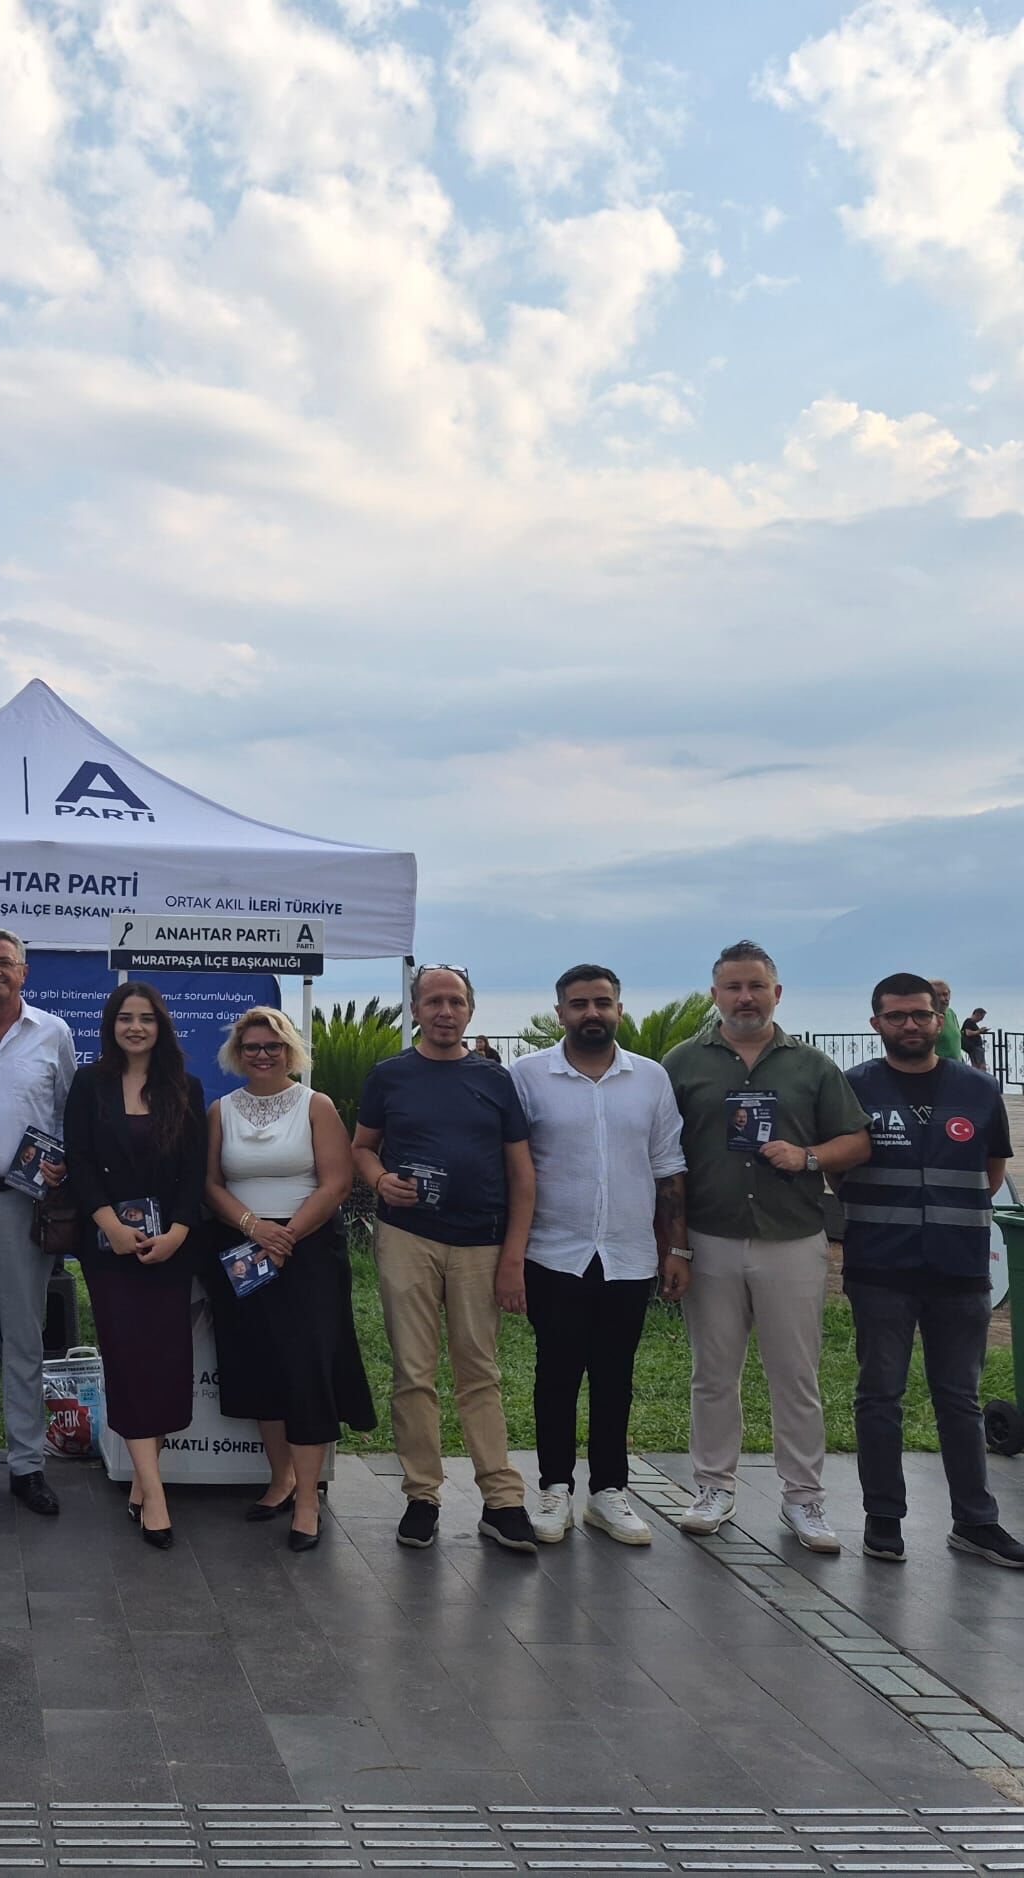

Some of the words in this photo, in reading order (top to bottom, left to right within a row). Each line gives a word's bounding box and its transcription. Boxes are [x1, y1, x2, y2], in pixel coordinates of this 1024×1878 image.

[55, 760, 151, 810] A
[68, 871, 139, 897] PARTİ
[21, 901, 51, 918] İLÇE
[165, 895, 212, 909] ORTAK
[215, 898, 245, 911] AKIL
[248, 896, 281, 912] İLERİ
[284, 899, 343, 915] TÜRKİYE
[155, 926, 232, 942] ANAHTAR
[296, 923, 314, 943] A
[131, 955, 202, 971] MURATPAŞA
[204, 953, 229, 970] İLÇE
[231, 956, 301, 971] BAŞKANLIĞI
[20, 989, 38, 999] dığı
[40, 989, 59, 1000] gibi
[161, 993, 182, 1001] muz
[184, 992, 256, 1003] sorumluluğun,
[51, 1009, 103, 1019] bitiremedi
[167, 1010, 214, 1020] zlarımıza
[216, 1011, 245, 1022] düşm
[78, 1028, 101, 1037] kald
[888, 1110, 904, 1126] A
[162, 1437, 208, 1451] AKATLİ
[212, 1438, 265, 1455] ŞÖHRET
